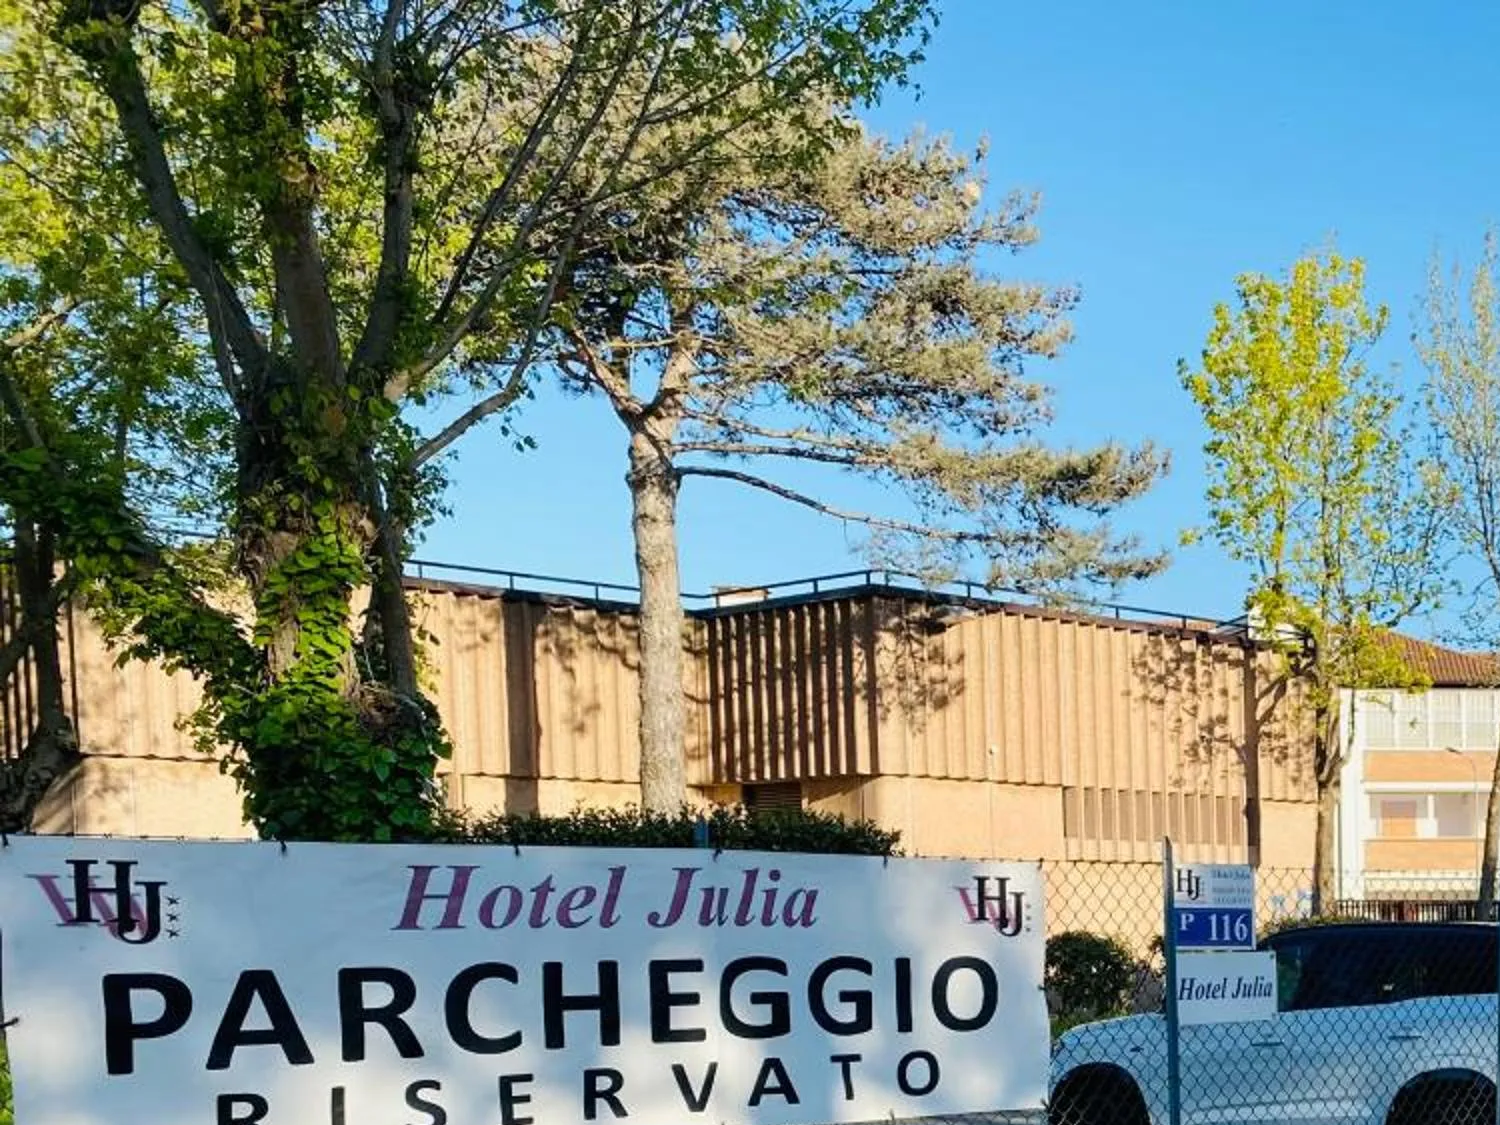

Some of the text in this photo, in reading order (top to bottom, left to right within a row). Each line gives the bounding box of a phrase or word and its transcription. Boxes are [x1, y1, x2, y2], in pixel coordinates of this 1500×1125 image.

[391, 864, 819, 932] Hotel Julia
[1179, 913, 1249, 942] P 116
[1179, 975, 1273, 1001] Hotel Julia
[102, 955, 999, 1077] PARCHEGGIO
